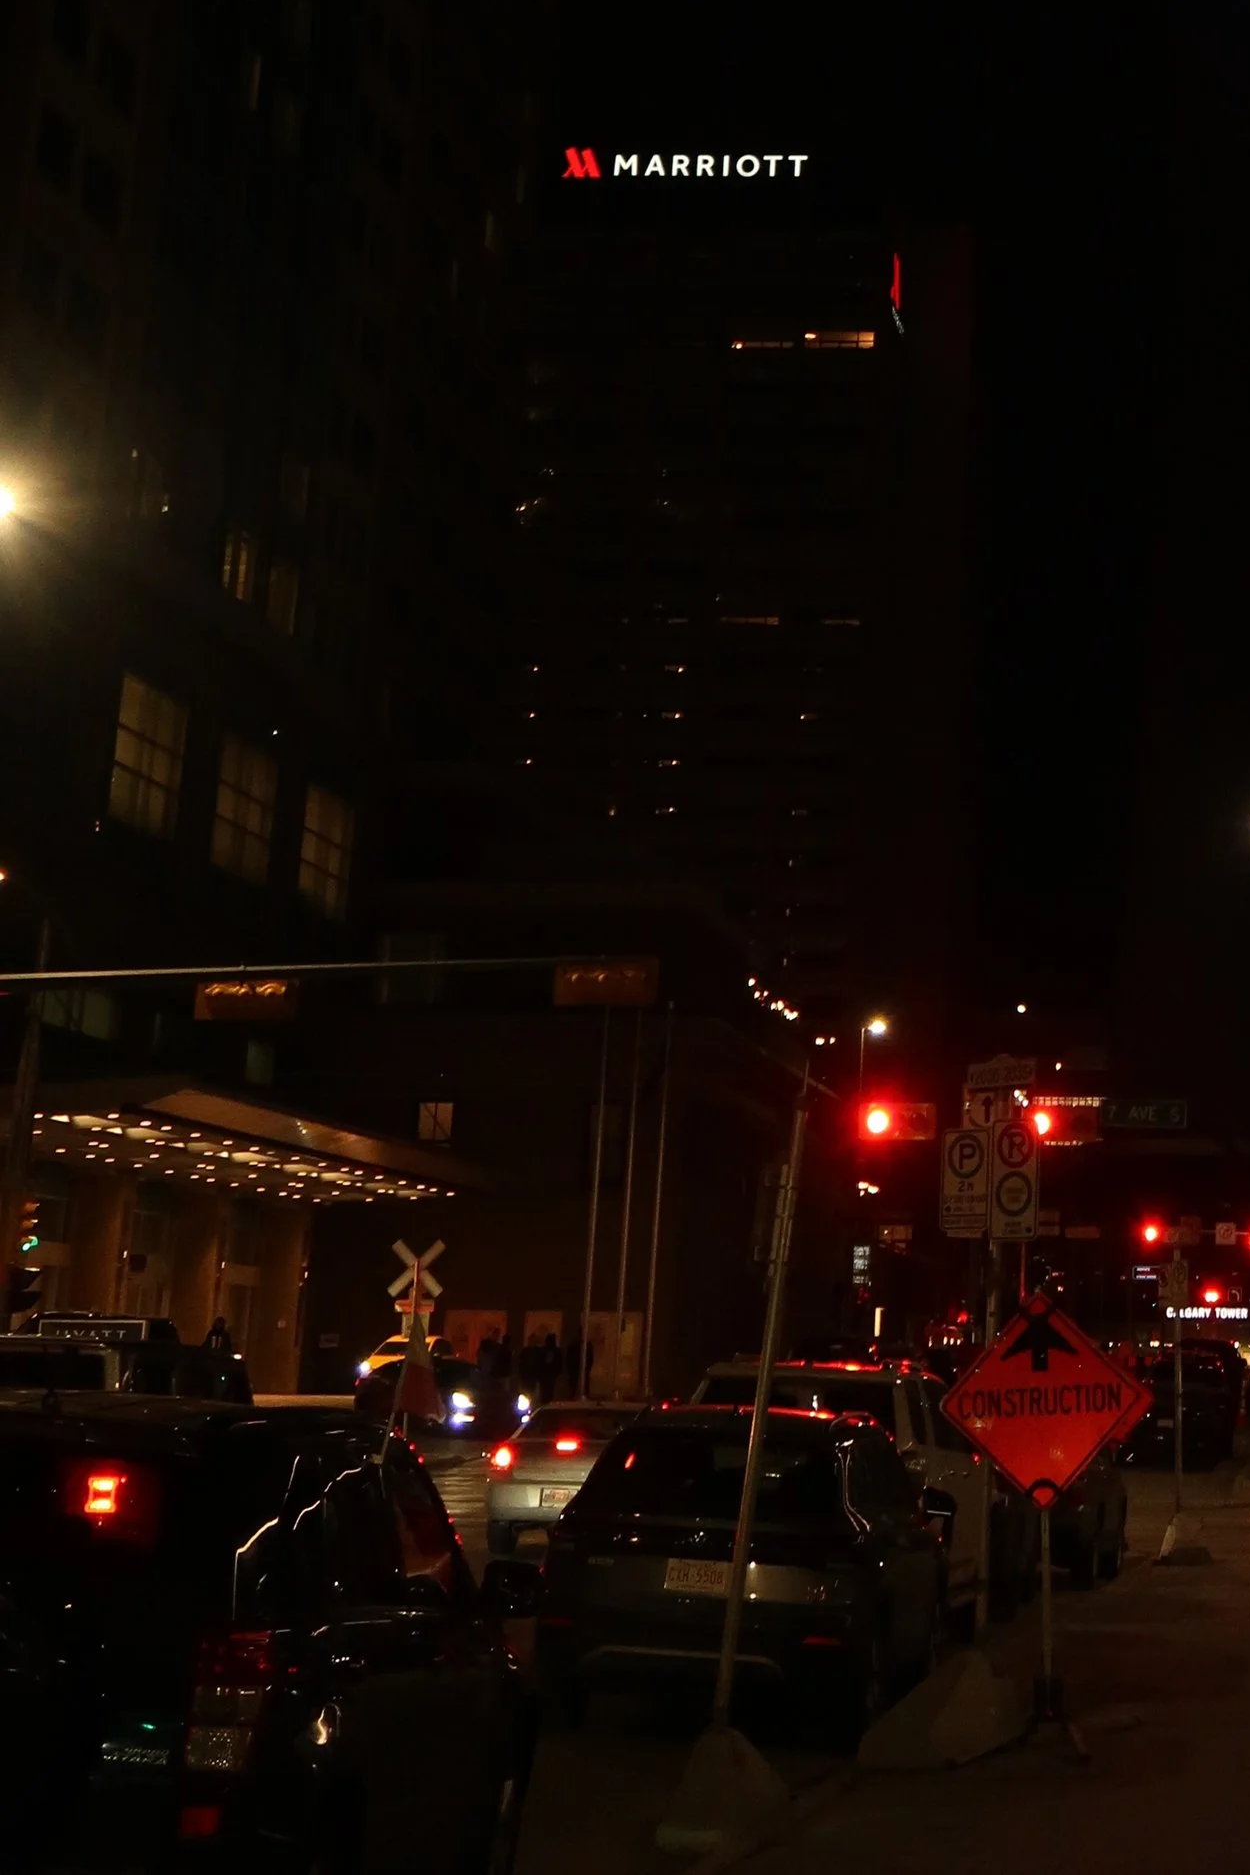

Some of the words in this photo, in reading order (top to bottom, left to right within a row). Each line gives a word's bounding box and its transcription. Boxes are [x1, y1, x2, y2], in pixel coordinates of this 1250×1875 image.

[612, 154, 809, 177] MARRIOTT
[1127, 1104, 1158, 1123] AVE
[1166, 1306, 1211, 1319] CLGARY
[1215, 1308, 1248, 1320] TOWER
[958, 1382, 1122, 1418] CONSTRUCTION
